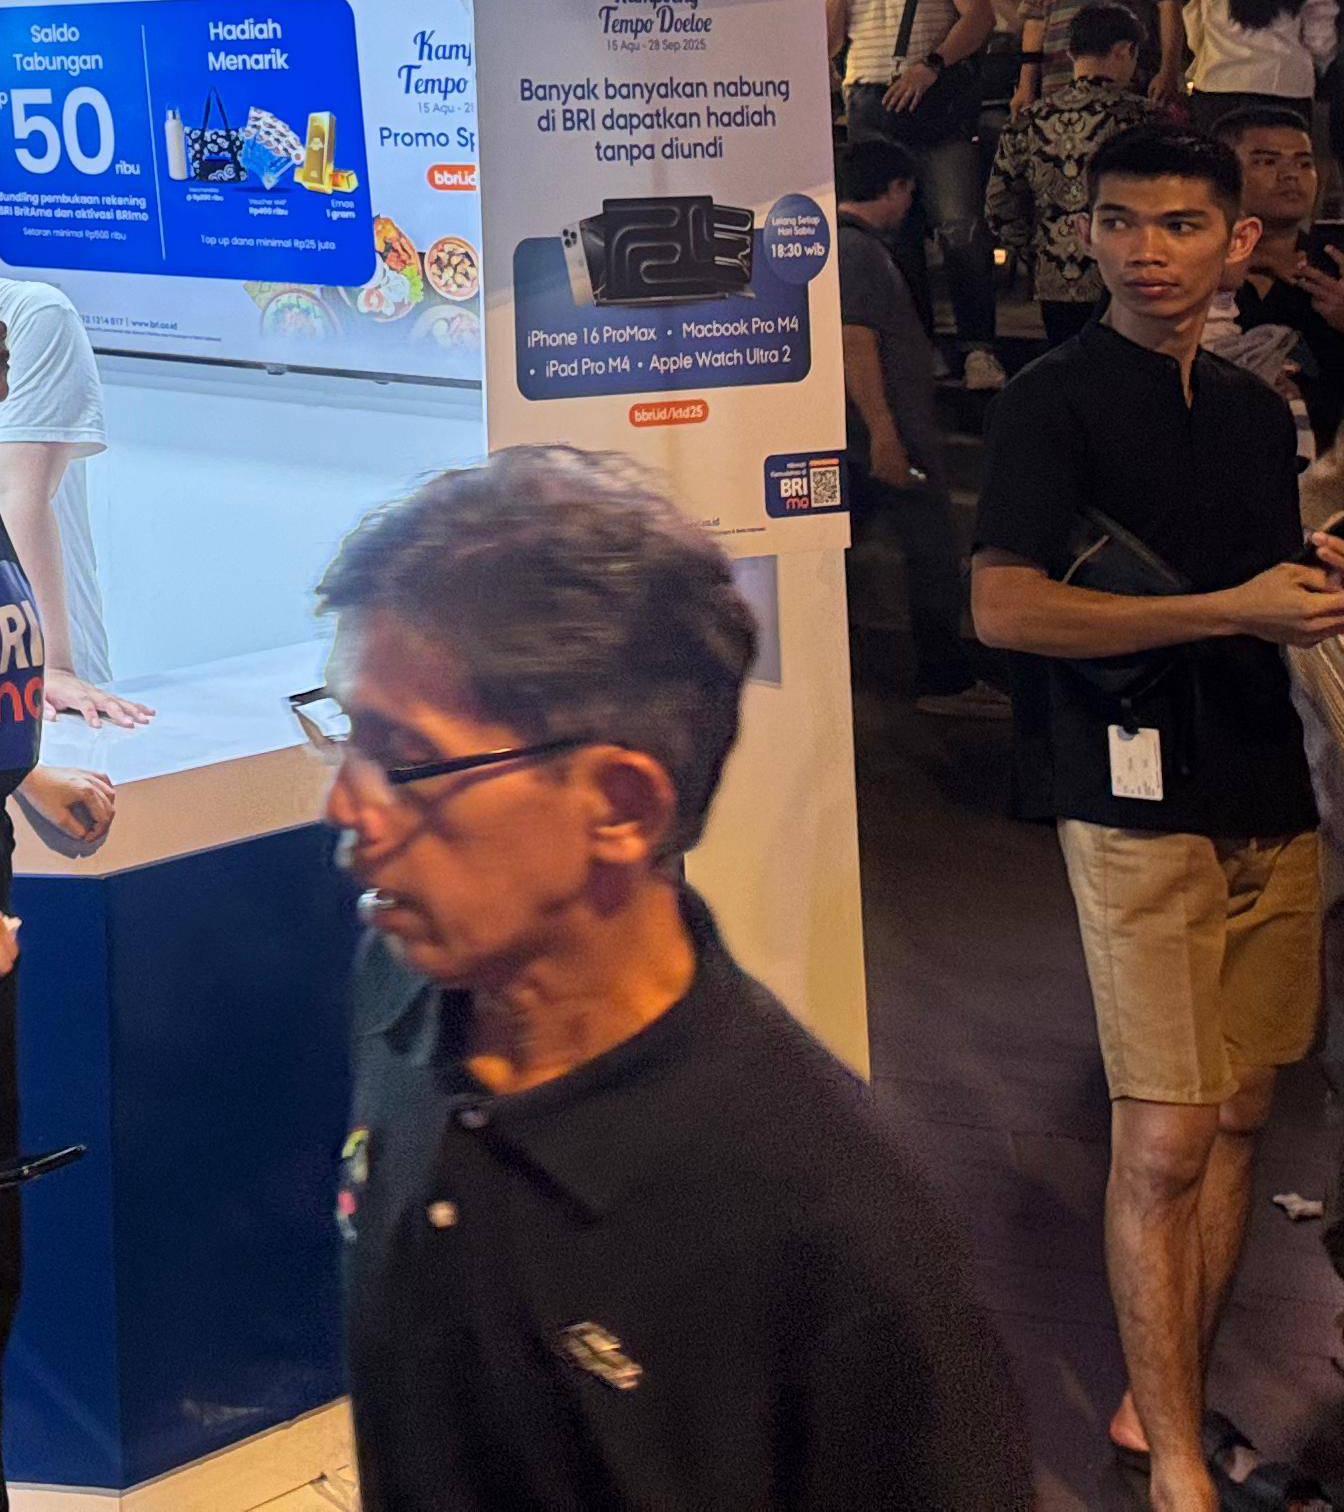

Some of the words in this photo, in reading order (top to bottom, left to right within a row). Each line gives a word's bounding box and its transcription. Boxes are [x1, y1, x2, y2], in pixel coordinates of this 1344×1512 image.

[209, 20, 282, 43] Hadiah
[598, 6, 654, 40] Tempo
[656, 4, 712, 33] Doeloe
[30, 25, 80, 44] Saldo
[607, 40, 618, 51] 15
[662, 39, 680, 53] Sep
[682, 38, 706, 50] 2025
[13, 51, 103, 76] Tabungan
[208, 50, 289, 73] Menarik
[397, 64, 468, 101] Tempo
[520, 77, 599, 105] Banyak
[604, 76, 708, 104] banyakan
[713, 75, 790, 102] nabung
[418, 102, 430, 113] 15
[11, 85, 115, 176] 50
[115, 159, 140, 175] ribu
[537, 109, 556, 132] di
[562, 109, 596, 132] BRI
[601, 106, 700, 135] dapatkan
[707, 104, 776, 128] hadiah
[379, 126, 450, 148] Promo
[595, 141, 656, 165] tanpa
[661, 136, 723, 160] diundi
[40, 192, 100, 206] pembukaan
[101, 194, 147, 209] rekening
[54, 208, 74, 219] dan
[75, 208, 115, 220] aktivasi
[201, 234, 217, 246] Top
[256, 237, 292, 248] minimal
[317, 240, 336, 252] juta
[772, 243, 802, 258] 18:30
[804, 242, 825, 256] wib
[527, 330, 577, 349] iPhone
[583, 327, 600, 345] 16
[603, 325, 657, 344] ProMax
[682, 319, 749, 339] Macbook
[752, 318, 775, 335] Pro
[777, 316, 799, 333] M4
[546, 359, 578, 378] iPad
[581, 356, 605, 376] Pro
[608, 355, 630, 374] M4
[649, 352, 693, 374] Apple
[696, 348, 743, 368] Watch
[746, 347, 779, 365] Ultra
[782, 345, 792, 363] 2
[780, 477, 808, 498] BRI
